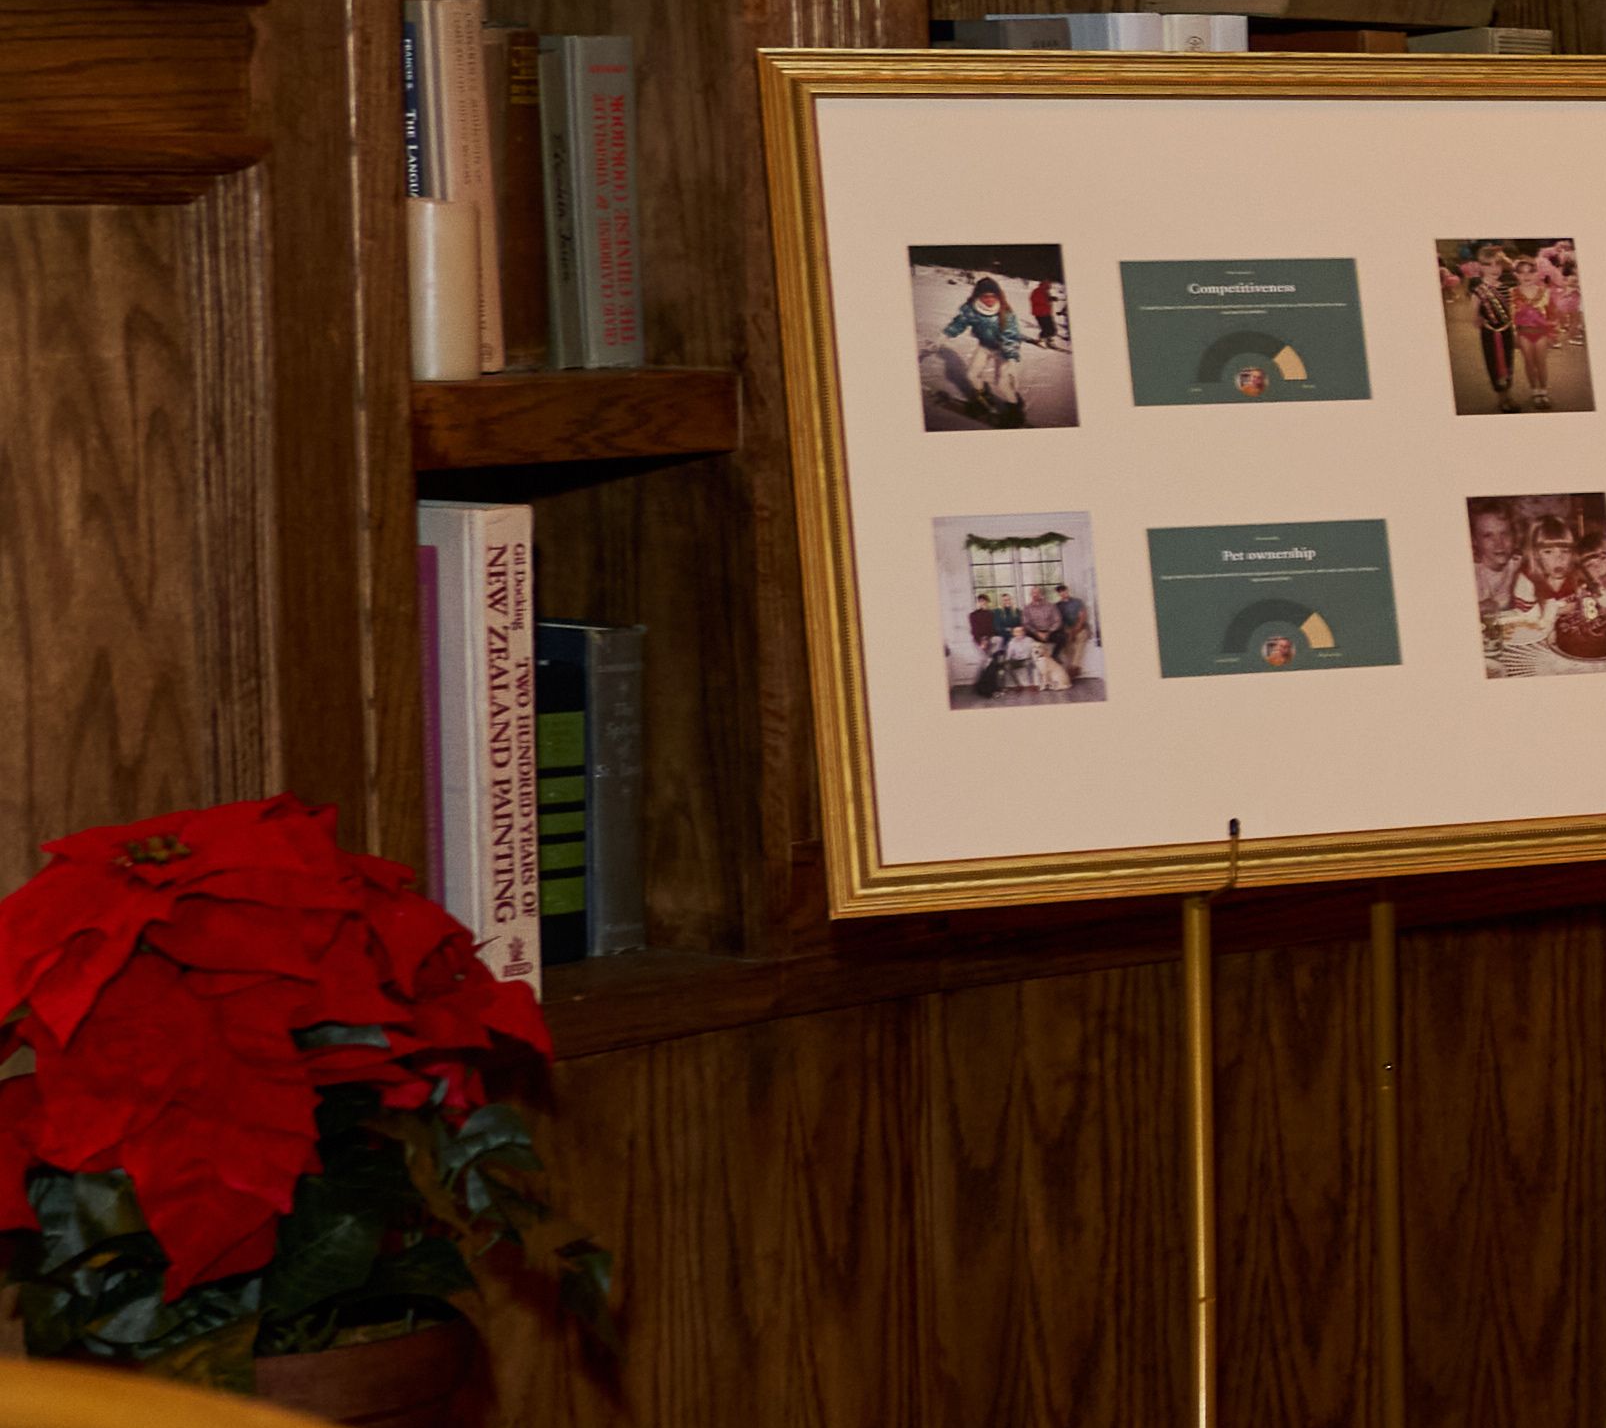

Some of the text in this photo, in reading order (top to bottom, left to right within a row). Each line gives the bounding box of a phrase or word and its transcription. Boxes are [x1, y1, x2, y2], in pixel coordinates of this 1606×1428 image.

[1187, 282, 1296, 296] Competitiveness
[1222, 547, 1316, 561] Pet ownership
[486, 545, 516, 924] NEW ZEALAND PAINTING
